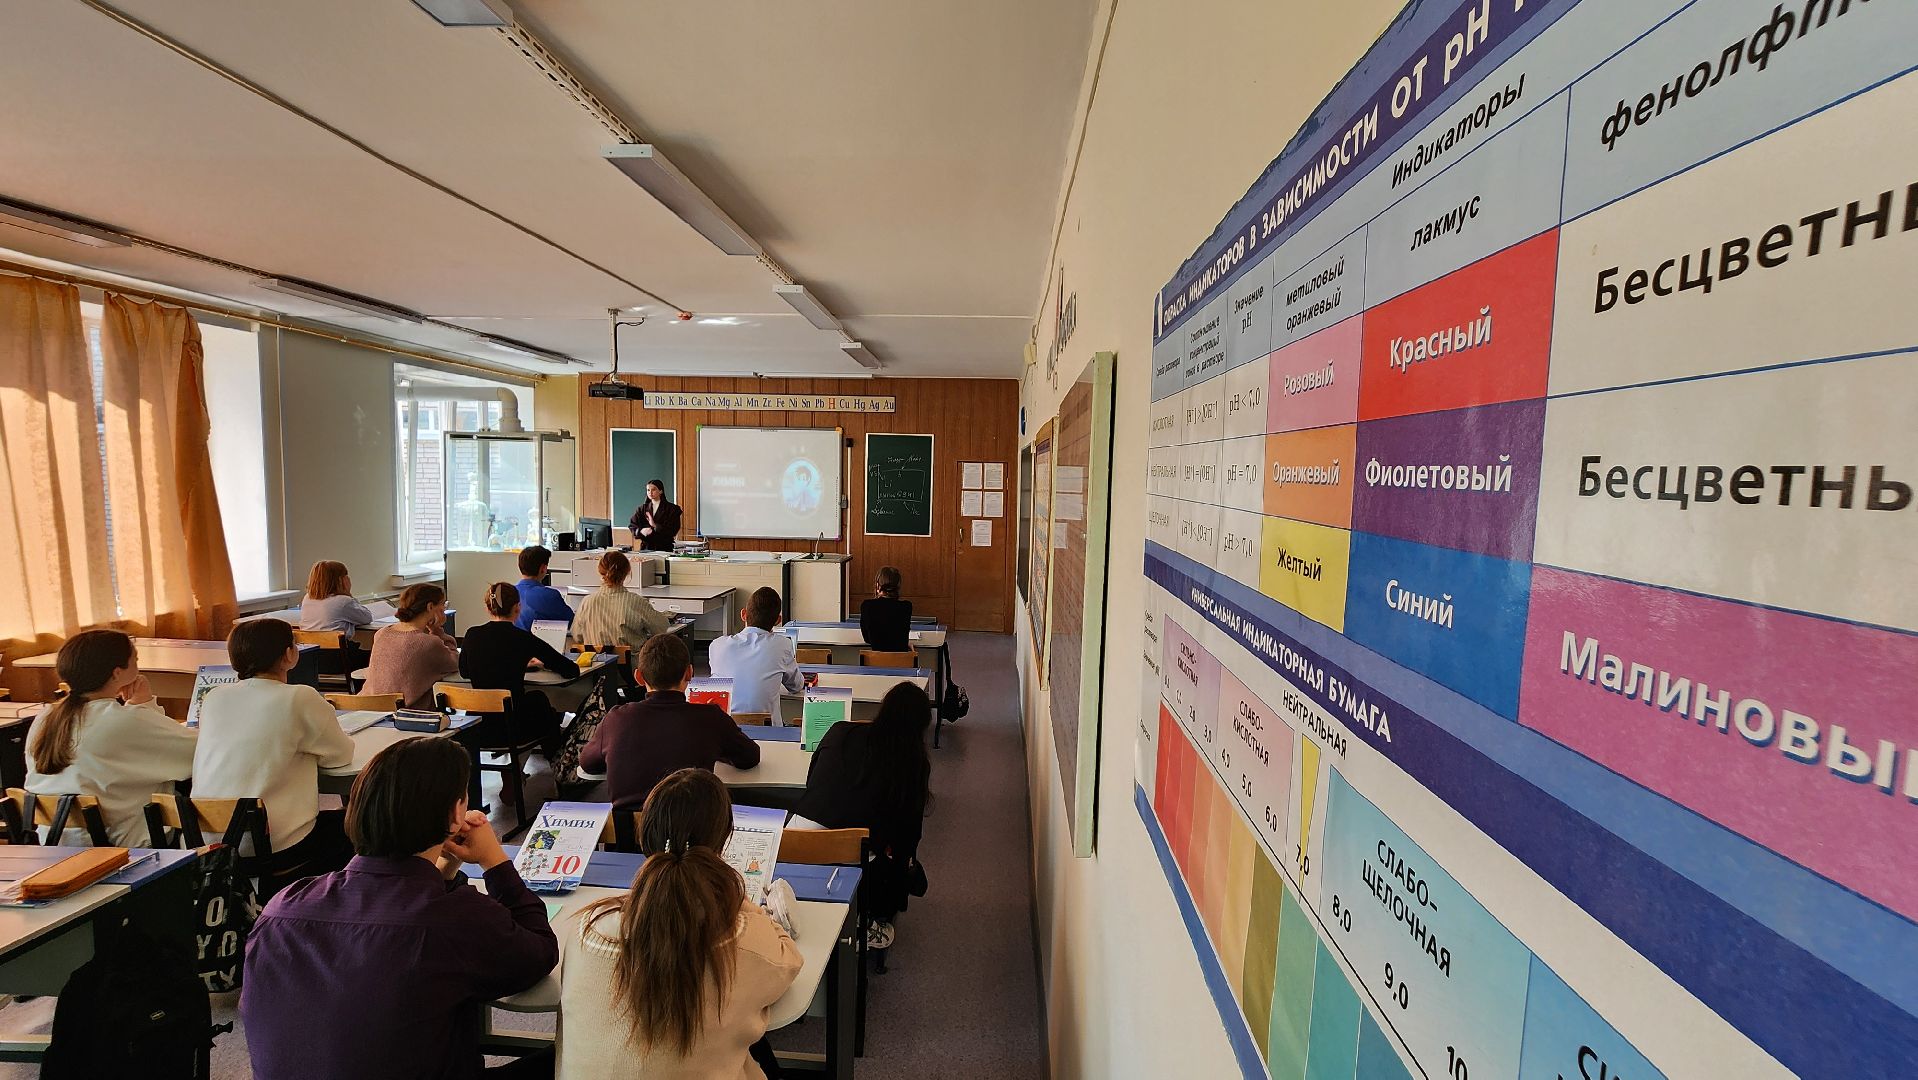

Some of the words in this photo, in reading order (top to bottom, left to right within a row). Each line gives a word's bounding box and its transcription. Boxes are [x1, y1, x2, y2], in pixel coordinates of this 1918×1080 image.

[1601, 0, 1871, 152] фенолфт
[1391, 72, 1526, 189] Индикаторы
[1189, 235, 1245, 305] ИНДИКАТОРОВ
[1250, 224, 1257, 250] В
[1262, 102, 1379, 239] ЗАВИСИМОСТИ
[1391, 55, 1428, 119] ОТ
[1443, 0, 1490, 85] pH
[1410, 195, 1481, 251] лакмус
[1594, 180, 1918, 314] Бесцветн
[1234, 285, 1264, 314] Значение
[1286, 254, 1344, 307] метиловый
[1241, 310, 1253, 334] pH
[1286, 284, 1342, 333] оранжевый
[1390, 304, 1493, 373] Красный
[1284, 360, 1335, 398] Розовый
[655, 396, 665, 406] Rb
[668, 396, 675, 406] K
[678, 397, 688, 407] Ba
[691, 397, 702, 407] Ca
[705, 397, 716, 407] Na
[718, 397, 731, 409] Mg
[734, 398, 743, 407] Al
[746, 397, 759, 408] Mn
[776, 398, 785, 408] Fe
[788, 397, 798, 408] Ni
[801, 398, 811, 408] Sn
[815, 398, 825, 408] Pb
[828, 397, 836, 409] H
[839, 399, 850, 409] Cu
[853, 399, 866, 411] Hg
[868, 399, 880, 411] Ag
[883, 399, 894, 410] Au
[1229, 393, 1240, 415] pH
[1227, 465, 1238, 484] pH
[1245, 465, 1257, 484] 7,0
[1272, 457, 1341, 489] Оранжевый
[1365, 453, 1513, 493] Фиолетовый
[1224, 533, 1235, 552] pH
[1277, 546, 1322, 581] Желтый
[1385, 579, 1454, 629] Синий
[199, 675, 239, 686] Хими
[1242, 619, 1324, 693] ИНДИКАТОРНАЯ
[1328, 675, 1392, 743] БУМАГА
[1239, 700, 1264, 732] СЛАБО-
[1282, 689, 1347, 761] НЕЙТРАЛЬНАЯ
[1221, 748, 1231, 769] 4,0
[1232, 715, 1270, 768] КИСЛОТНАЯ
[1241, 773, 1252, 798] 5,0
[537, 814, 596, 829] Химия
[1265, 805, 1278, 833] 6,0
[547, 855, 581, 875] 10
[1295, 843, 1310, 876] 7,0
[1377, 840, 1438, 912] СЛАБО-
[1332, 894, 1352, 933] 8,0
[1362, 858, 1452, 979] ЩЕЛОЧНАЯ
[1384, 962, 1409, 1010] 9,0
